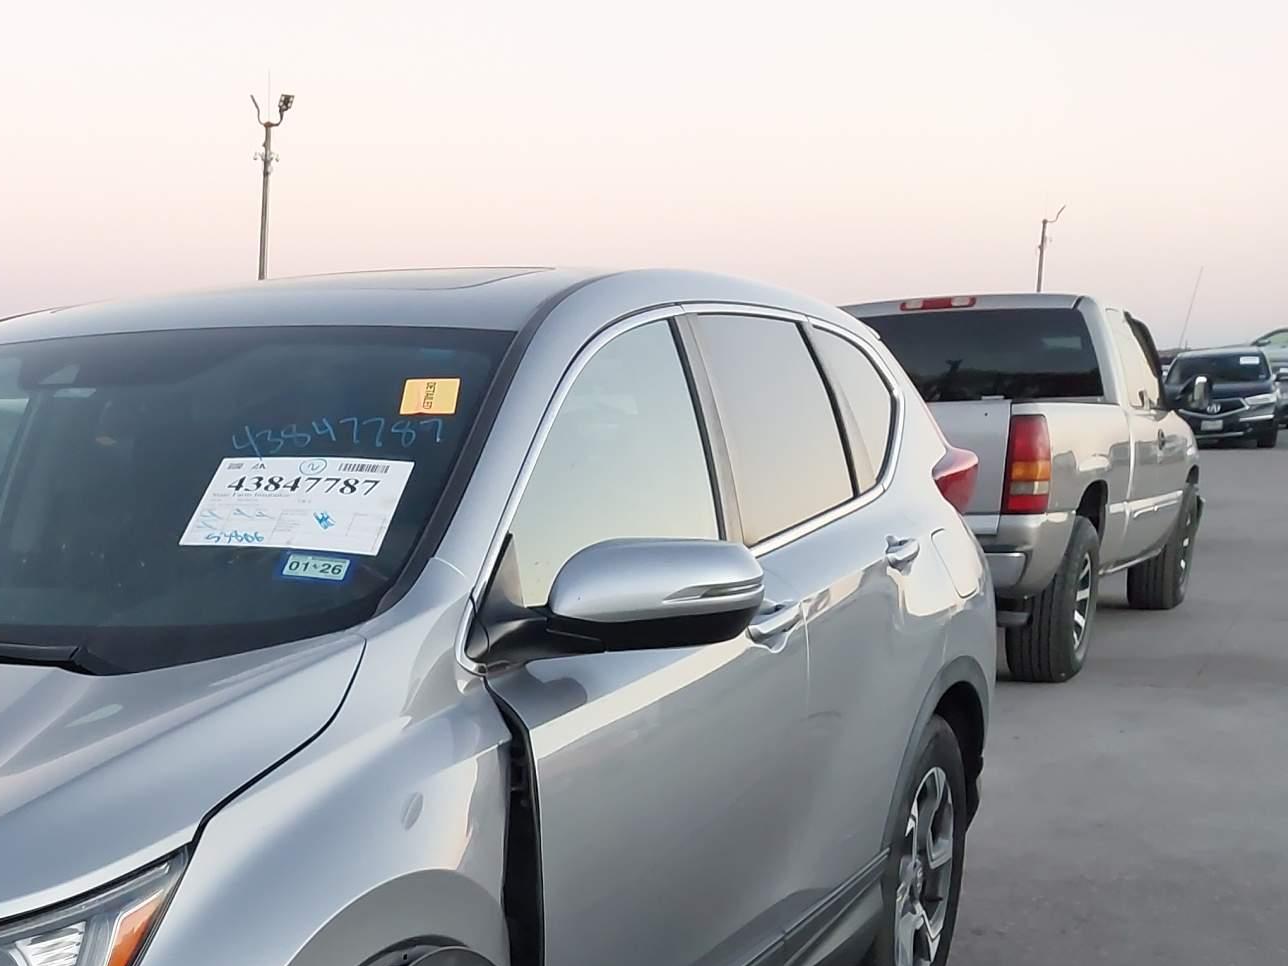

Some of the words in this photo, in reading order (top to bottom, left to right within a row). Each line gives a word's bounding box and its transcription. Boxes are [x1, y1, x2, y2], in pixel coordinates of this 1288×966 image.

[232, 417, 444, 461] 43847787
[227, 475, 381, 497] 43847787
[288, 560, 310, 573] 01
[319, 562, 344, 576] 26
